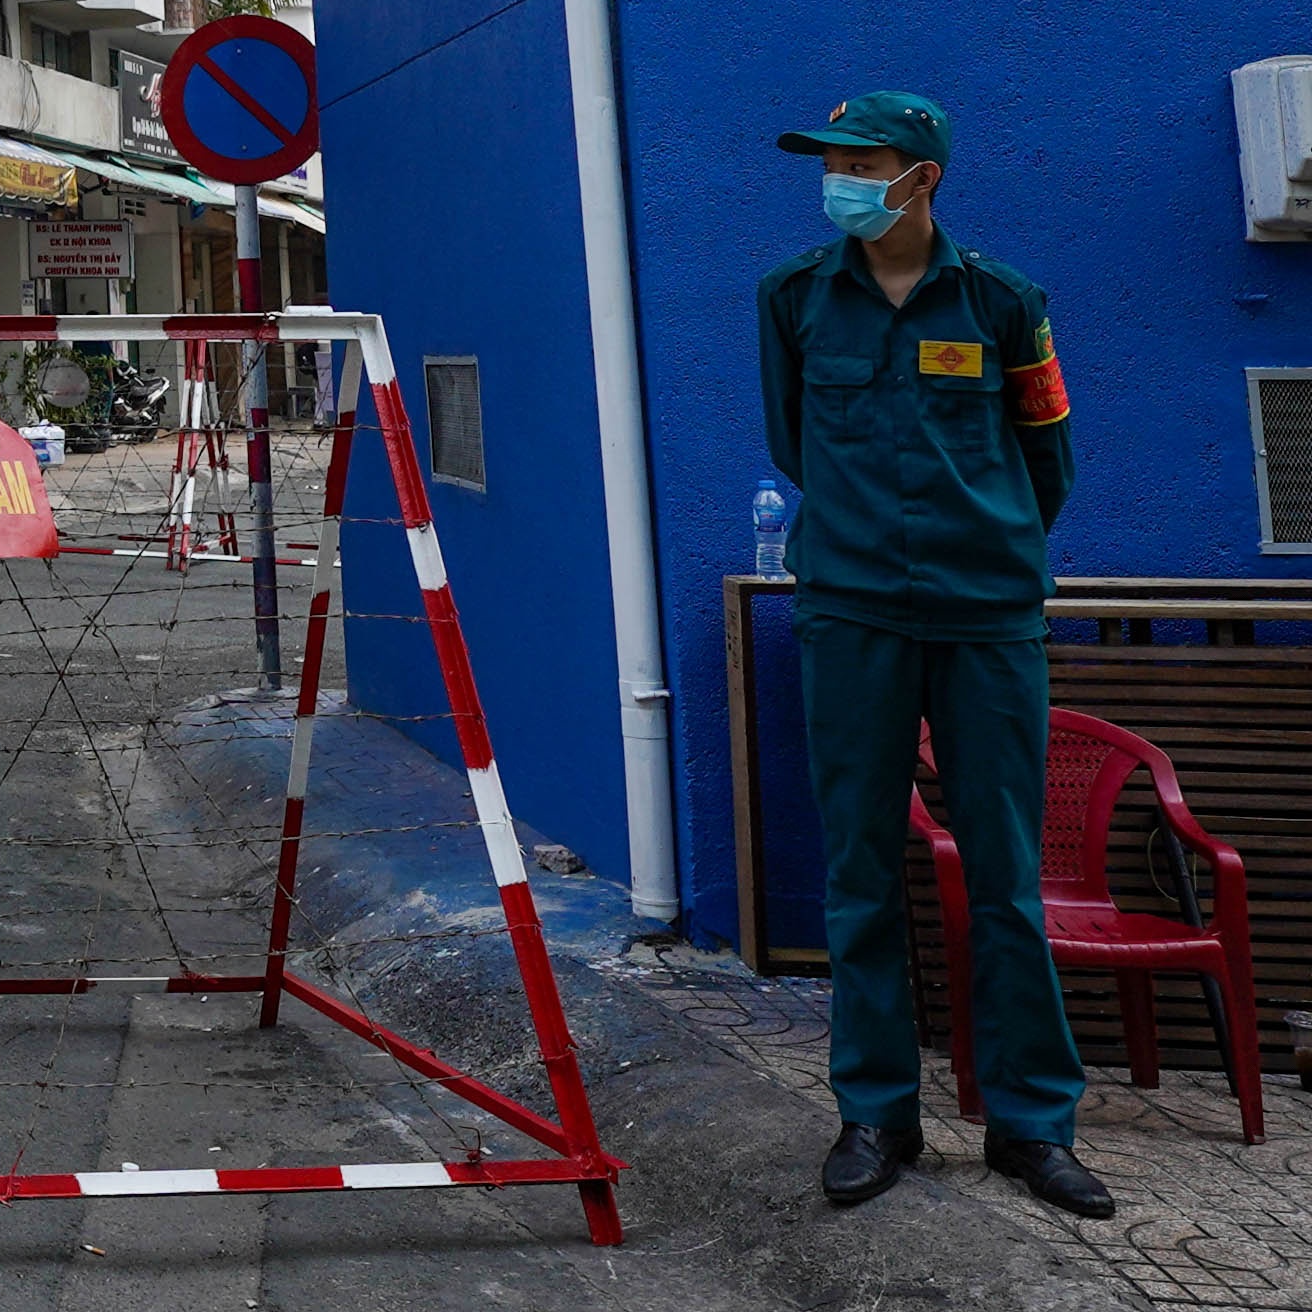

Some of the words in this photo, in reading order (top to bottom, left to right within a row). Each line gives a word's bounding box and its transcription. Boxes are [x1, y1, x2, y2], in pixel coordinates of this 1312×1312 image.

[63, 223, 92, 233] THANH
[93, 223, 123, 233] PHONG
[71, 236, 86, 248] NỘI
[88, 237, 112, 246] KHOA
[53, 253, 87, 264] NGUYỄN
[90, 254, 103, 265] THỊ
[45, 266, 78, 276] CHUYÊN
[80, 267, 103, 276] KHOA
[104, 267, 120, 276] NHI
